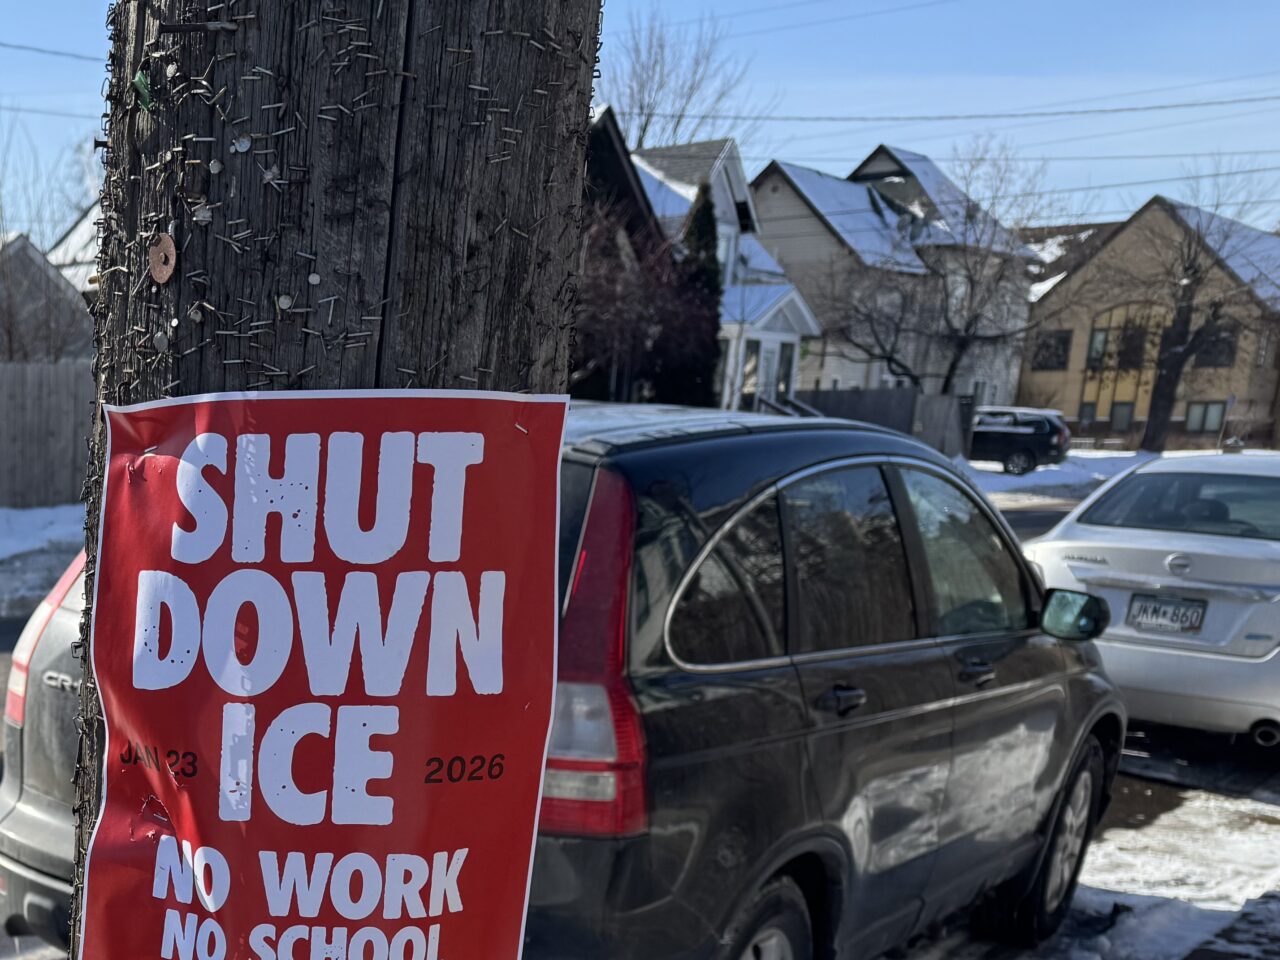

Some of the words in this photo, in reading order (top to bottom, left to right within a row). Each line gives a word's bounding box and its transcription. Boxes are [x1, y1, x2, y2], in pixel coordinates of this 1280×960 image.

[171, 431, 484, 564] SHUT
[132, 568, 506, 697] DOWN
[120, 740, 160, 772] JAN
[165, 750, 198, 778] 23
[218, 702, 400, 825] ICE
[424, 754, 505, 784] 2026
[152, 835, 231, 913] NO
[258, 848, 469, 920] WORK
